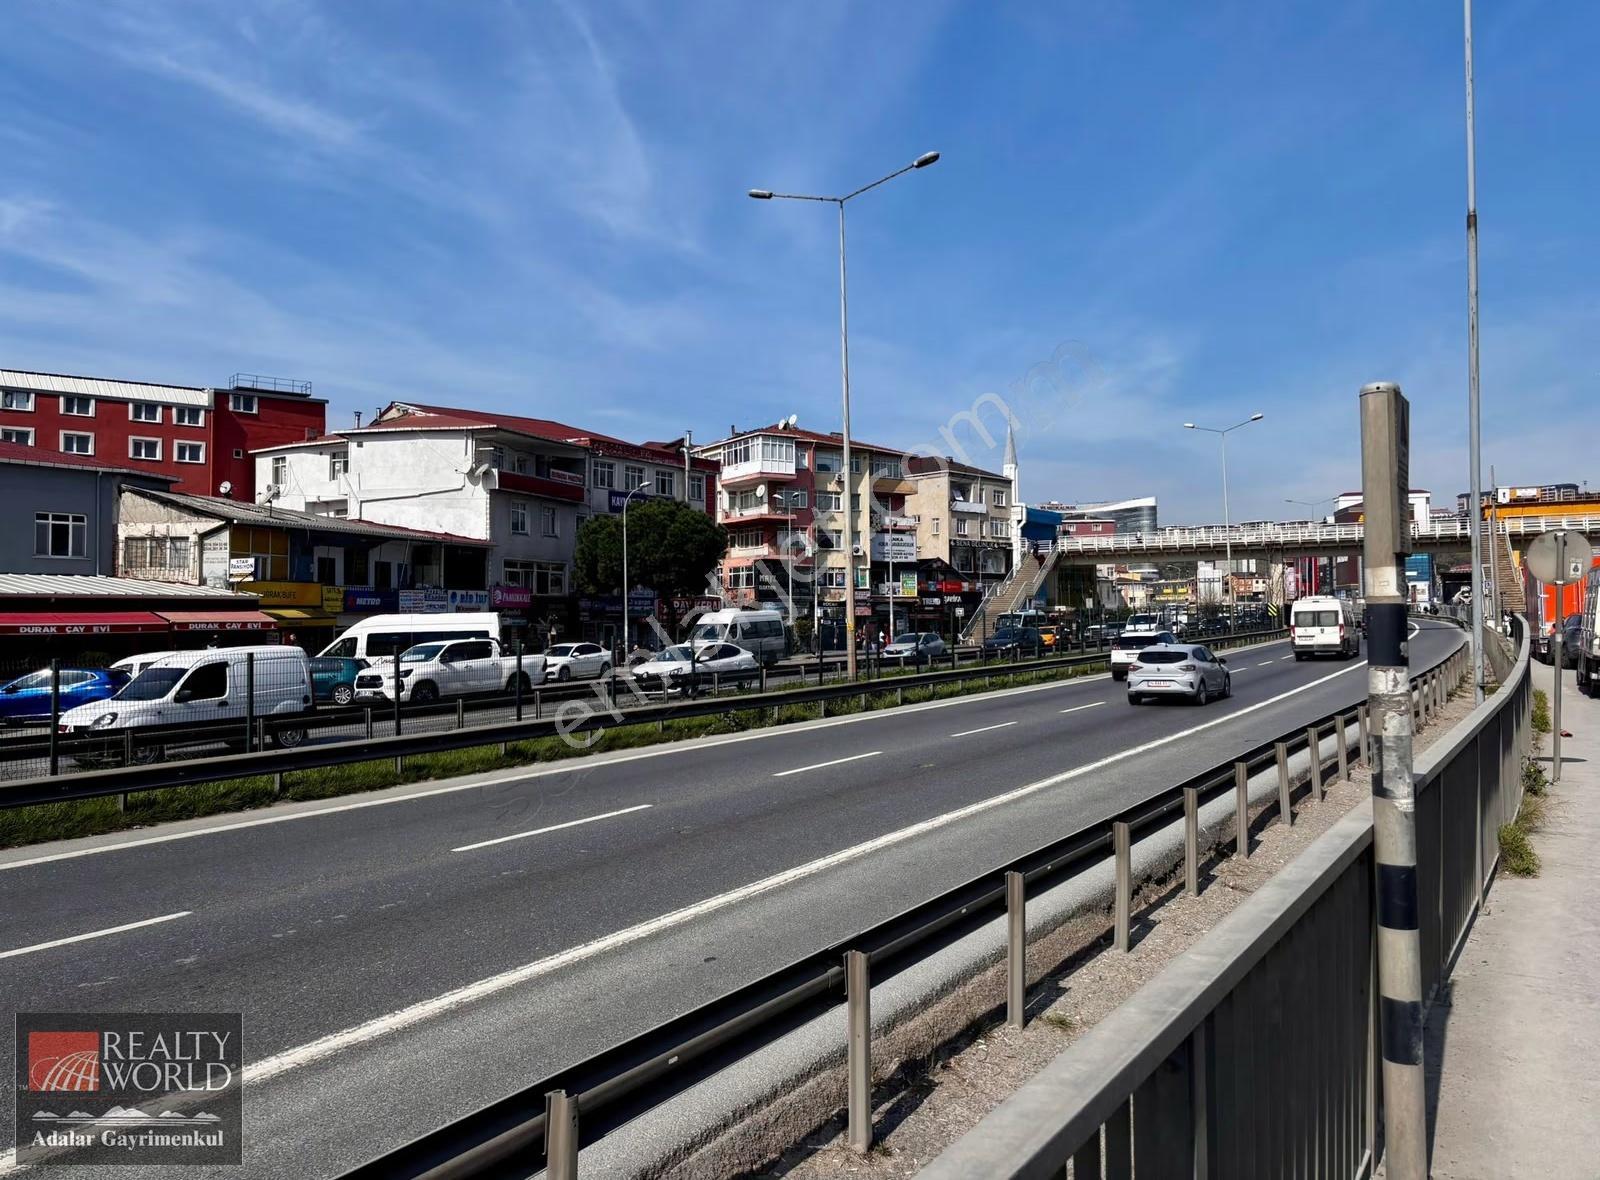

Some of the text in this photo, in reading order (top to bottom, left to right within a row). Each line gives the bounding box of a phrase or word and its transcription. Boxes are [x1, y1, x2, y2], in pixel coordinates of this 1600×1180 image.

[356, 597, 381, 606] METRO
[922, 597, 941, 605] TREND
[65, 626, 85, 634] ÇAY
[92, 624, 111, 633] EVİ
[225, 622, 242, 631] ÇAY
[246, 621, 262, 630] EVİ
